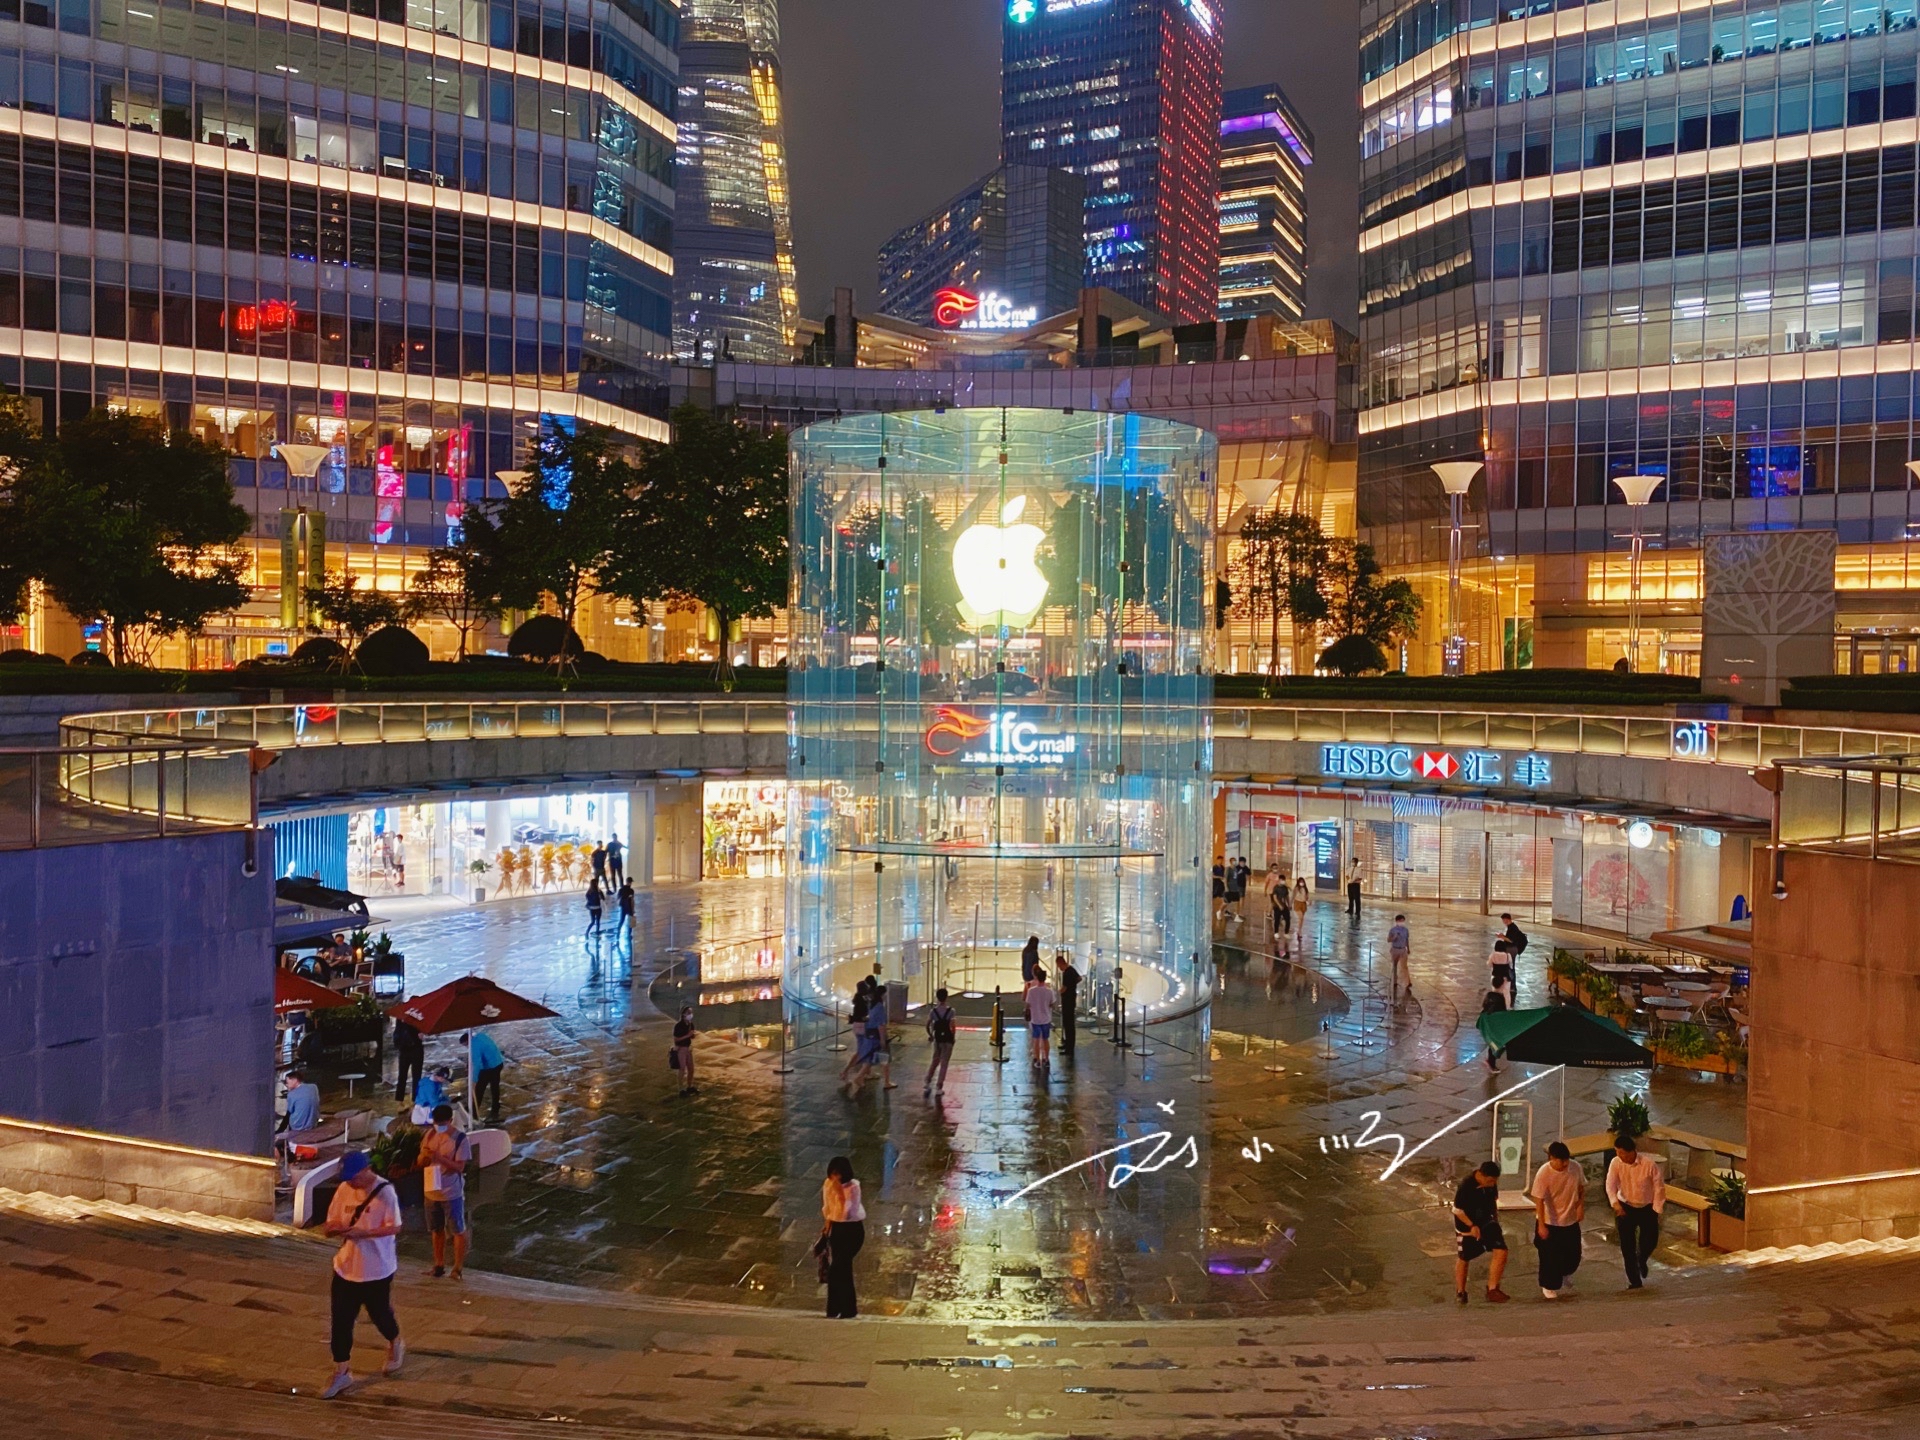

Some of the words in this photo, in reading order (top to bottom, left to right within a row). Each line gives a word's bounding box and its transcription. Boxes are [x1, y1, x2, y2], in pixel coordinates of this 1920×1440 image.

[1012, 306, 1037, 320] mall
[310, 527, 322, 584] GUCC
[1039, 735, 1076, 753] mall
[1322, 745, 1412, 777] HSBC
[1462, 751, 1552, 787] 汇丰
